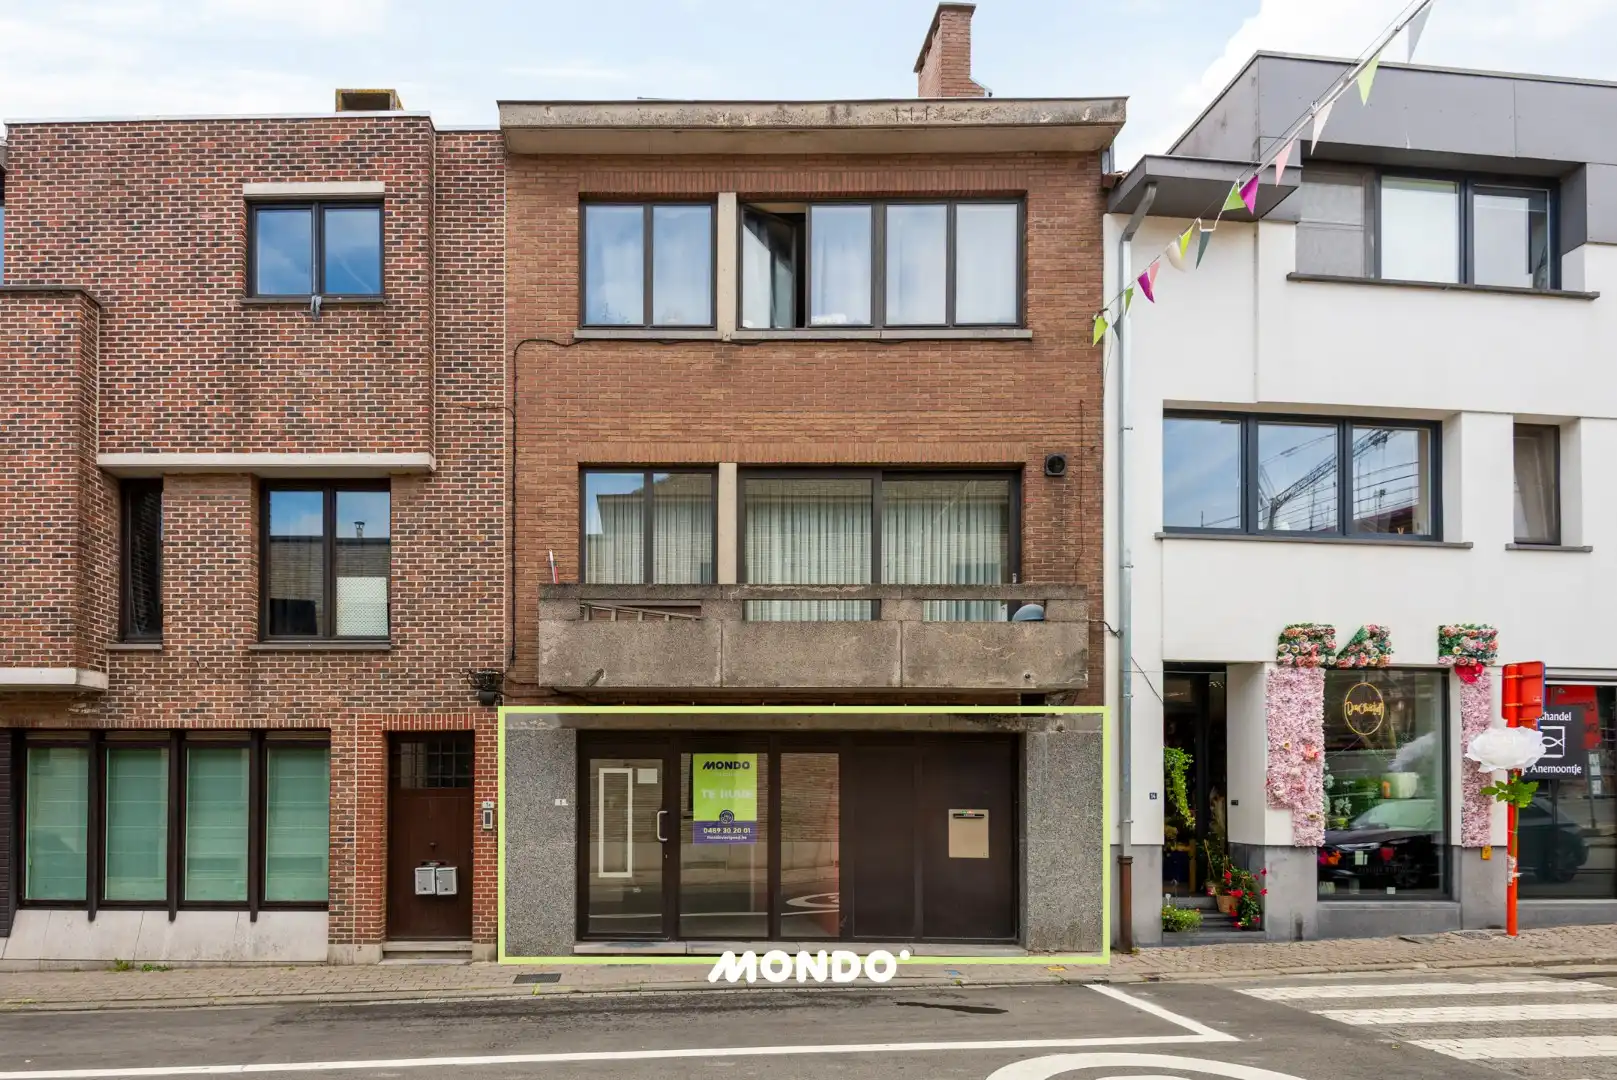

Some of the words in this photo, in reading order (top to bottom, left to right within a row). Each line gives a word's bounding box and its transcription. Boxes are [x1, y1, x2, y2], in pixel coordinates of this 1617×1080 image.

[1539, 711, 1572, 721] shandel
[702, 761, 750, 770] MONDO
[1530, 763, 1582, 775] Anemoontje
[701, 788, 716, 800] TE
